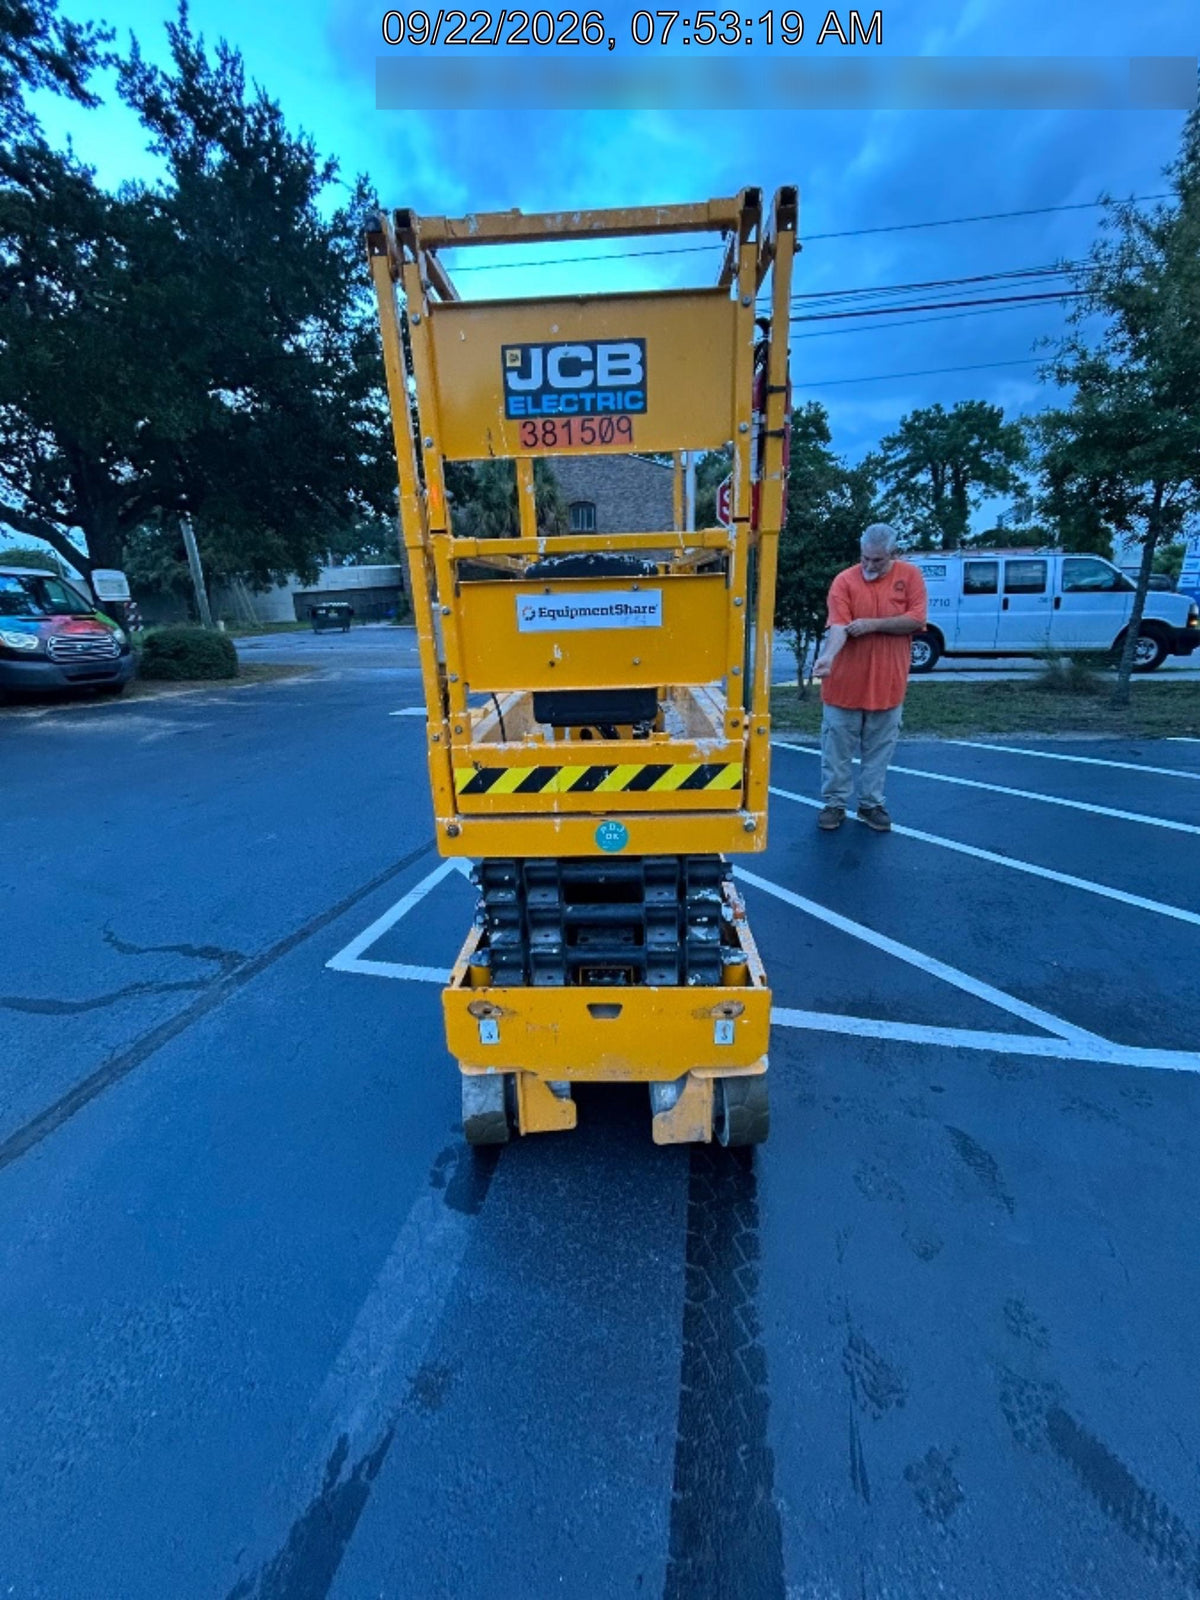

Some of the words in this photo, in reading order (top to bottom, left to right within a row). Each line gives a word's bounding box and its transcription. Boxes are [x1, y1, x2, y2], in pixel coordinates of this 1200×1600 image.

[506, 343, 644, 391] JCB
[508, 390, 645, 416] ELECTRIC
[521, 415, 633, 448] 381509
[538, 603, 657, 621] EquipmentShare
